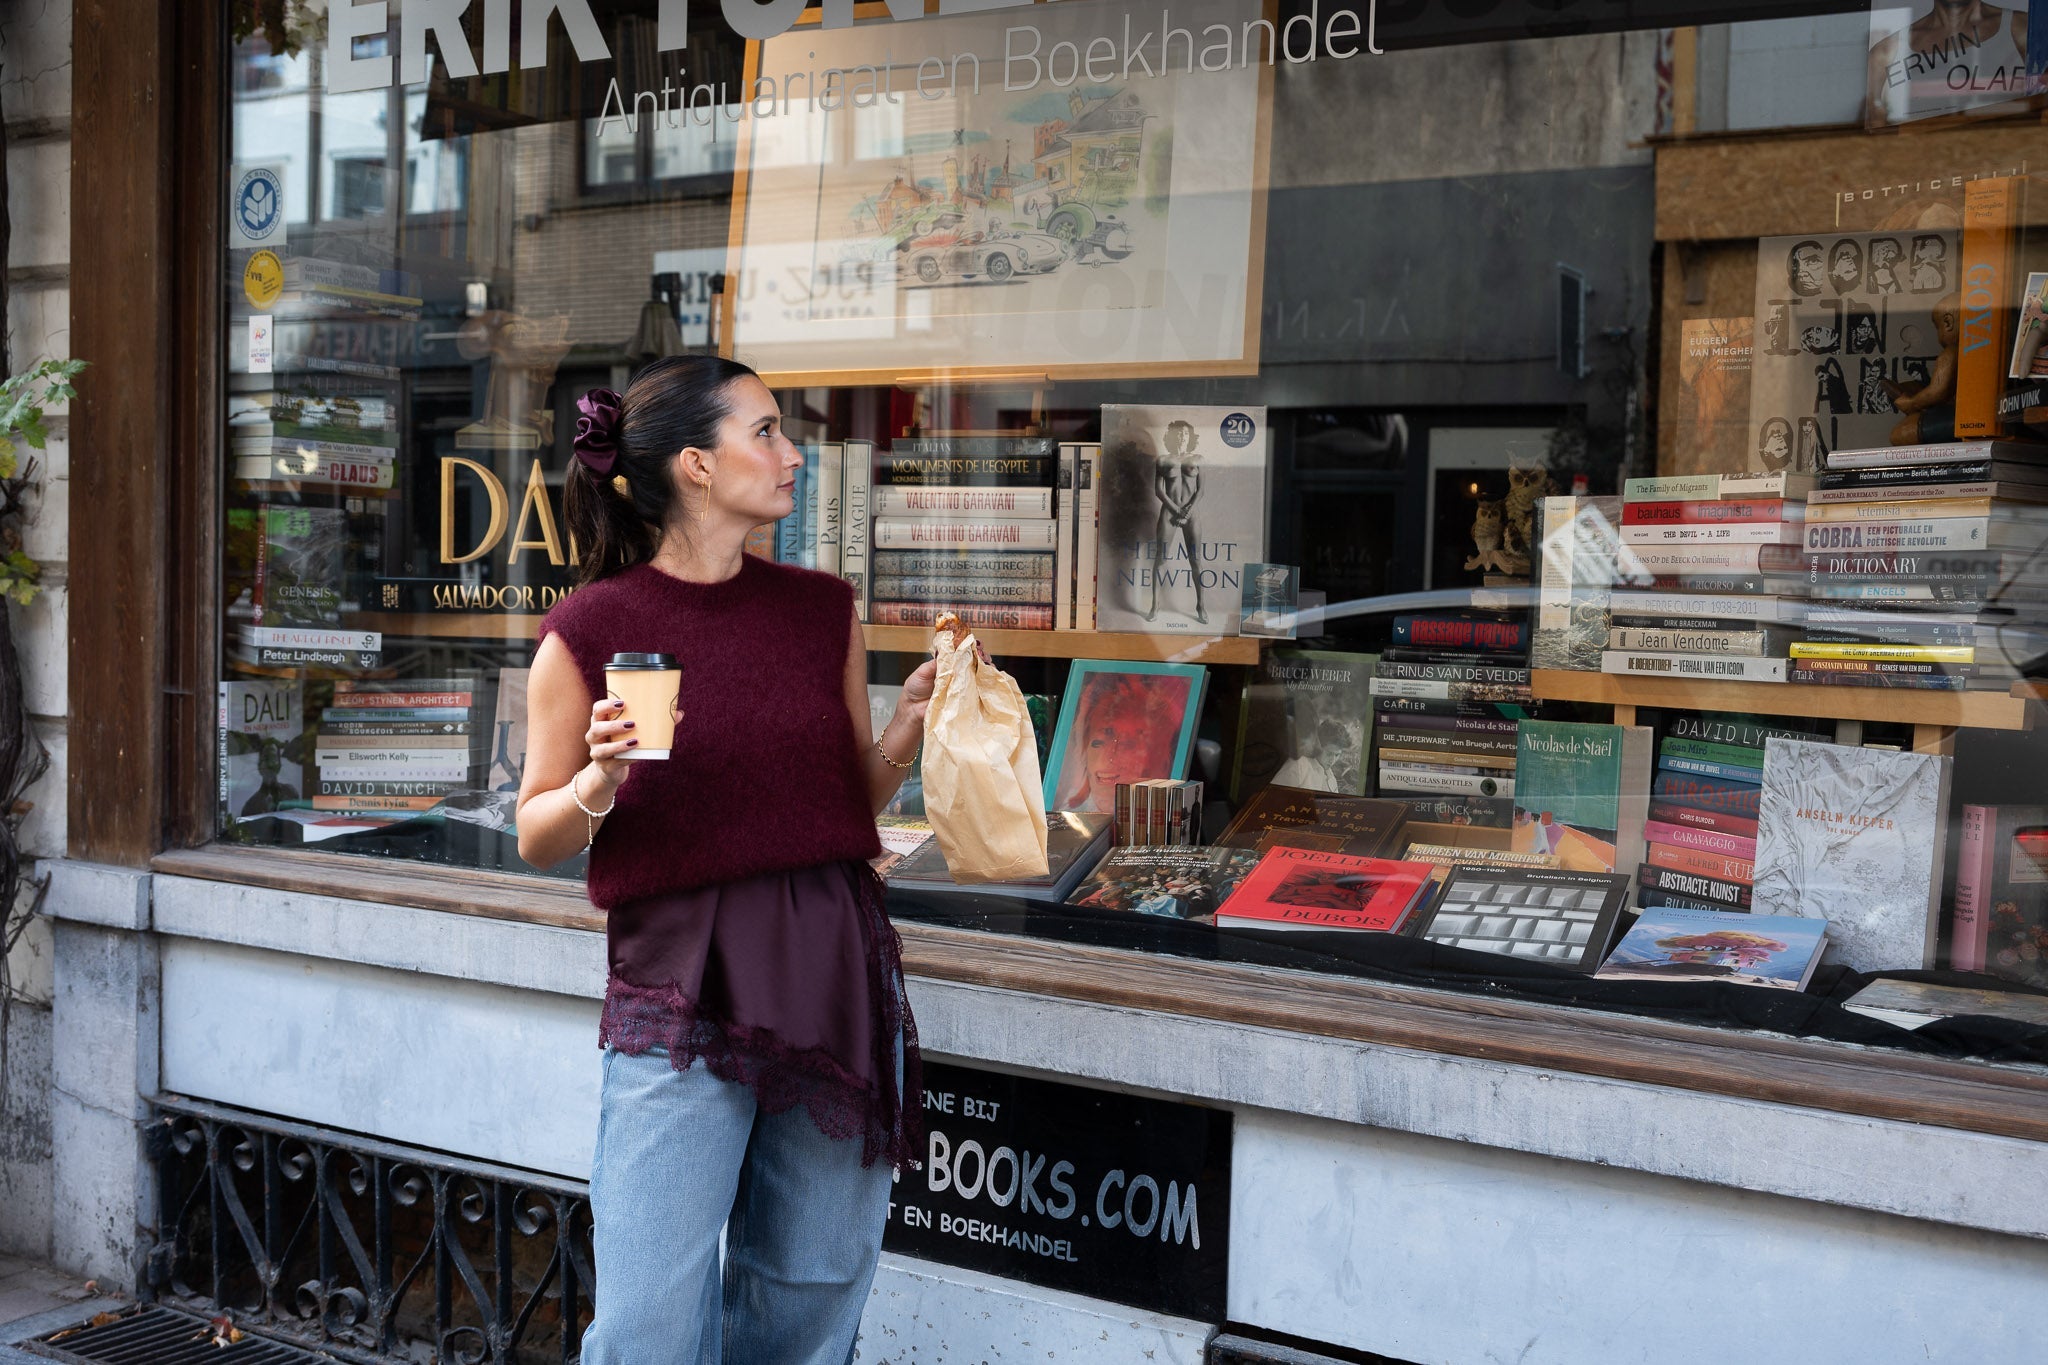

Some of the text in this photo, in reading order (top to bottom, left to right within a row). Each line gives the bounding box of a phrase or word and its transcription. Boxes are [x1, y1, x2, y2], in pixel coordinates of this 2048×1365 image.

[1886, 25, 1982, 89] ERWIN
[595, 50, 898, 143] Antiquariaat
[915, 50, 982, 102] en
[1003, 0, 1385, 95] Boekhandel
[1946, 64, 2026, 91] OLAF
[1787, 234, 1947, 297] CORB
[1963, 263, 1996, 357] GOYA
[1690, 336, 1728, 346] EUGEEN
[1998, 389, 2041, 415] JOHN VINK
[1227, 419, 1251, 435] 20
[1959, 422, 1986, 430] TASCHEN
[1885, 447, 1956, 461] Creative Homes
[330, 462, 379, 484] CLAUS
[892, 459, 963, 474] MONUMENTS
[965, 459, 979, 473] DE
[1859, 468, 1948, 481] Helmut Newton Berlin, Berlin
[1962, 466, 1985, 474] TASCHEN
[1636, 483, 1709, 495] The Family of Migrants
[906, 492, 1015, 511] VALENTINO GARAVANI
[1637, 504, 1753, 520] bauhaus imaginista
[1855, 504, 1900, 518] Artemisia
[821, 497, 839, 545] PARIS
[846, 485, 866, 559] PRAGUE
[911, 524, 1020, 543] VALENTINO GARAVANI
[1679, 530, 1698, 538] DEVIL
[1707, 530, 1713, 538] A
[1716, 530, 1731, 538] LIFE
[1809, 524, 1934, 549] COBRA EEN PICTURALE EN
[1866, 536, 1947, 547] POËTISCHE REVOLUTIE
[256, 534, 265, 584] GENESIS
[1123, 541, 1238, 562] HELMUT
[1811, 556, 1819, 583] BERKO
[1829, 557, 1921, 574] DICTIONARY
[1117, 568, 1241, 589] NEWTON
[1695, 580, 1734, 591] RICORSO
[279, 585, 332, 599] GENESIS
[433, 584, 535, 610] SALVADOR
[1867, 587, 1907, 596] ENGELS
[1664, 619, 1717, 628] DIRK BRAECKMAN
[1410, 620, 1472, 647] passage
[1638, 632, 1729, 651] Jean Vendome
[263, 649, 345, 665] Peter Lindbergh
[360, 653, 373, 668] 45
[1271, 665, 1351, 683] BRUCE WEBER
[1397, 665, 1526, 683] RINUS VAN DE VELDE
[1628, 657, 1745, 676] DE BOERENTOREN VERHAAL VAN EEN ICOON
[1797, 670, 1815, 680] Tal R
[1810, 662, 1868, 671] CONSTANTIN MEUNIER
[1881, 664, 1898, 672] GENESE
[1898, 664, 1908, 672] VAN
[1908, 665, 1916, 673] EEN
[1916, 665, 1932, 673] BEELD
[1284, 680, 1334, 692] My Education
[244, 683, 291, 723] DALÍ
[369, 695, 461, 704] STYNEN ARCHITECT
[1383, 701, 1426, 711] CARTIER
[1456, 720, 1519, 731] Nicolas de Staël
[1677, 718, 1737, 744] DAVID
[1383, 733, 1395, 741] DIE
[1451, 739, 1464, 747] von
[1465, 739, 1494, 749] Bruegel,
[1524, 733, 1613, 757] Nicolas de Staël
[1666, 741, 1687, 753] Joan
[1687, 743, 1708, 756] Miró
[349, 752, 409, 763] Ellsworth Kelly
[1668, 759, 1720, 775] HET ALBUM VAN DE DUIVEL
[322, 782, 436, 795] DAVID LYNCH
[1386, 774, 1418, 784] ANTIQUE
[1419, 777, 1440, 785] GLASS
[1441, 779, 1473, 787] BOTTLES
[1680, 813, 1715, 825] CHRIS BURDEN
[1796, 807, 1894, 831] ANSELM KIEFER
[1673, 830, 1736, 851] CARAVAGGIO
[1277, 850, 1373, 868] JOËLLE
[1414, 845, 1547, 864] EUGEEN VAN MIEGHEM
[1526, 873, 1566, 881] Brutalism
[1577, 876, 1613, 884] Belgium
[1658, 871, 1709, 897] ABSTRACTE
[1709, 880, 1740, 903] KUNST
[1282, 909, 1387, 927] DUBOIS
[963, 1095, 1001, 1123] BIJ
[903, 1205, 932, 1229] EN
[940, 1212, 1079, 1263] BOEKHANDEL
